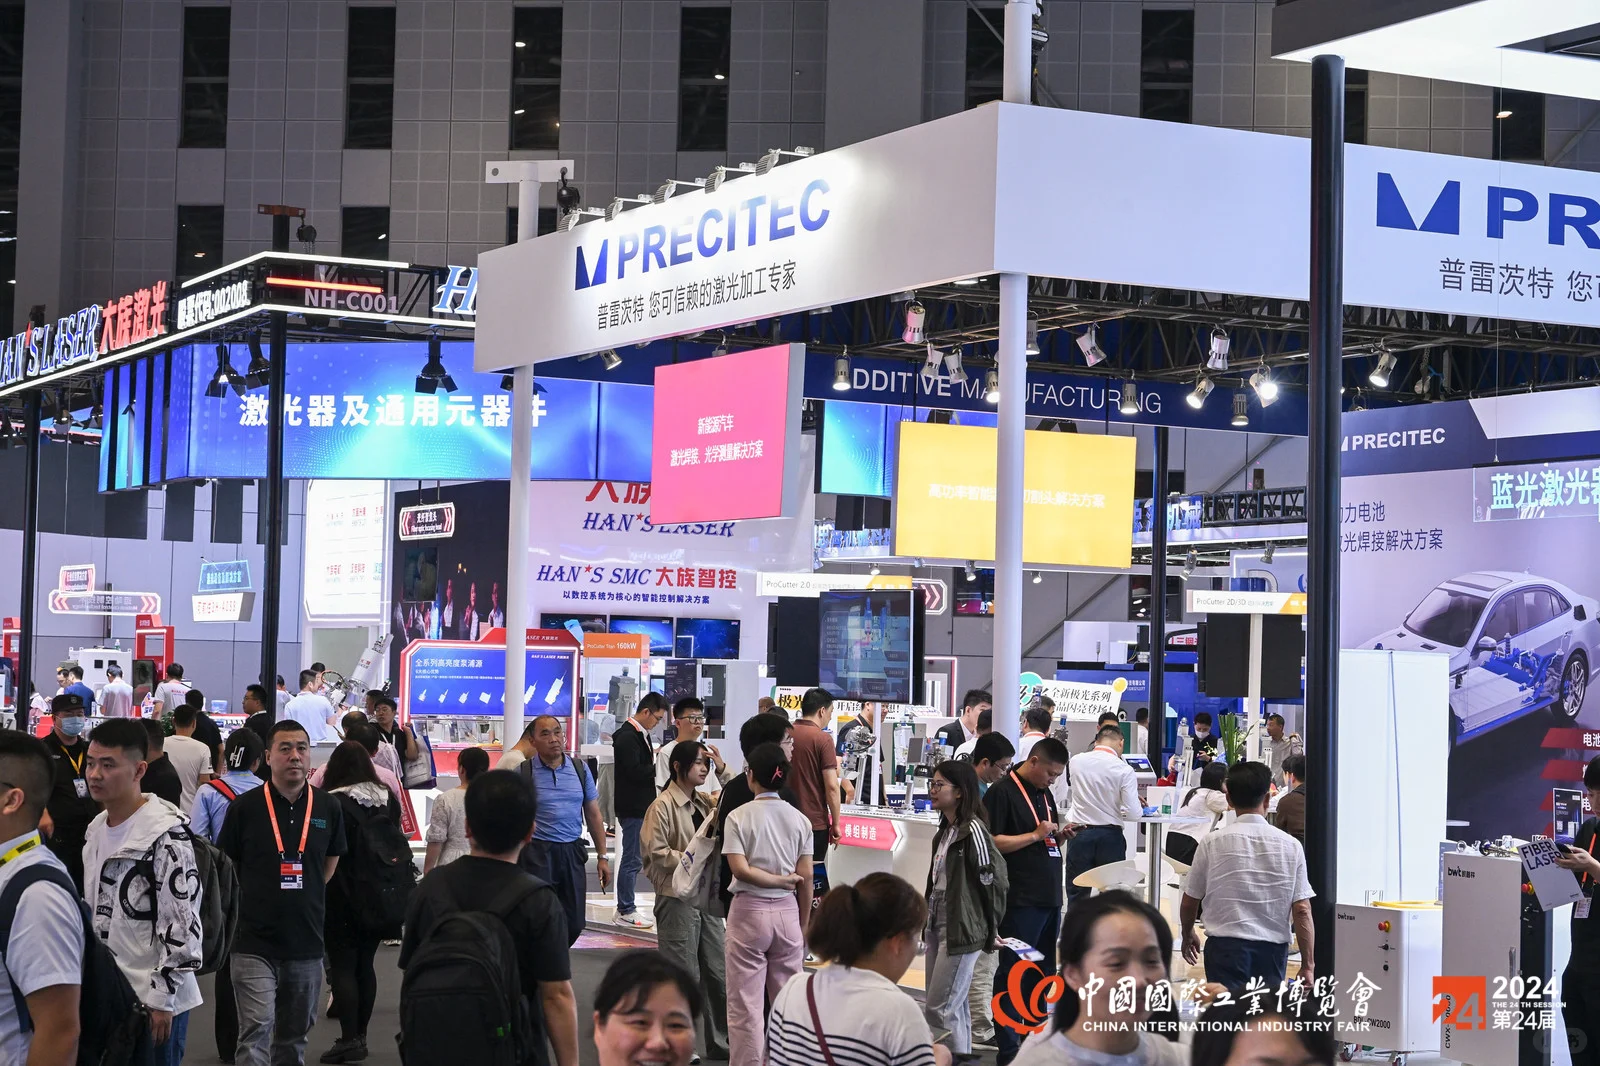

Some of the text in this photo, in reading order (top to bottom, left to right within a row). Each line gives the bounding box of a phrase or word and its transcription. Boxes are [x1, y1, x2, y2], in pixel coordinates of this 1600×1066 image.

[617, 178, 831, 279] PRECITEC
[1439, 257, 1600, 302] 普雷茨特 您
[304, 288, 399, 314] NH-C001
[597, 259, 797, 331] 普雷茨特 您可信赖的激光加工专家
[99, 280, 167, 354] 大族激光
[0, 303, 100, 388] AN'S LASER
[853, 367, 1161, 413] DDITIVE MAFACTURNG
[697, 413, 734, 435] 新能源汽车
[1351, 427, 1446, 451] PRECITEC
[670, 439, 763, 467] 激光焊接、光学测量解决方案
[608, 567, 651, 586] SMC
[655, 566, 737, 590] 大族智控
[766, 580, 799, 589] ProCutter
[800, 581, 811, 589] 2.0
[563, 590, 710, 605] 以数控系统为核心的智能控制解决方案
[415, 658, 483, 668] 全系列高亮度泵浦源
[1052, 687, 1112, 703] 全新极光系列
[1055, 700, 1113, 715] 品闪亮登场!
[844, 823, 877, 841] 模组制造
[1521, 841, 1555, 859] FIBER
[1526, 851, 1565, 871] LASER
